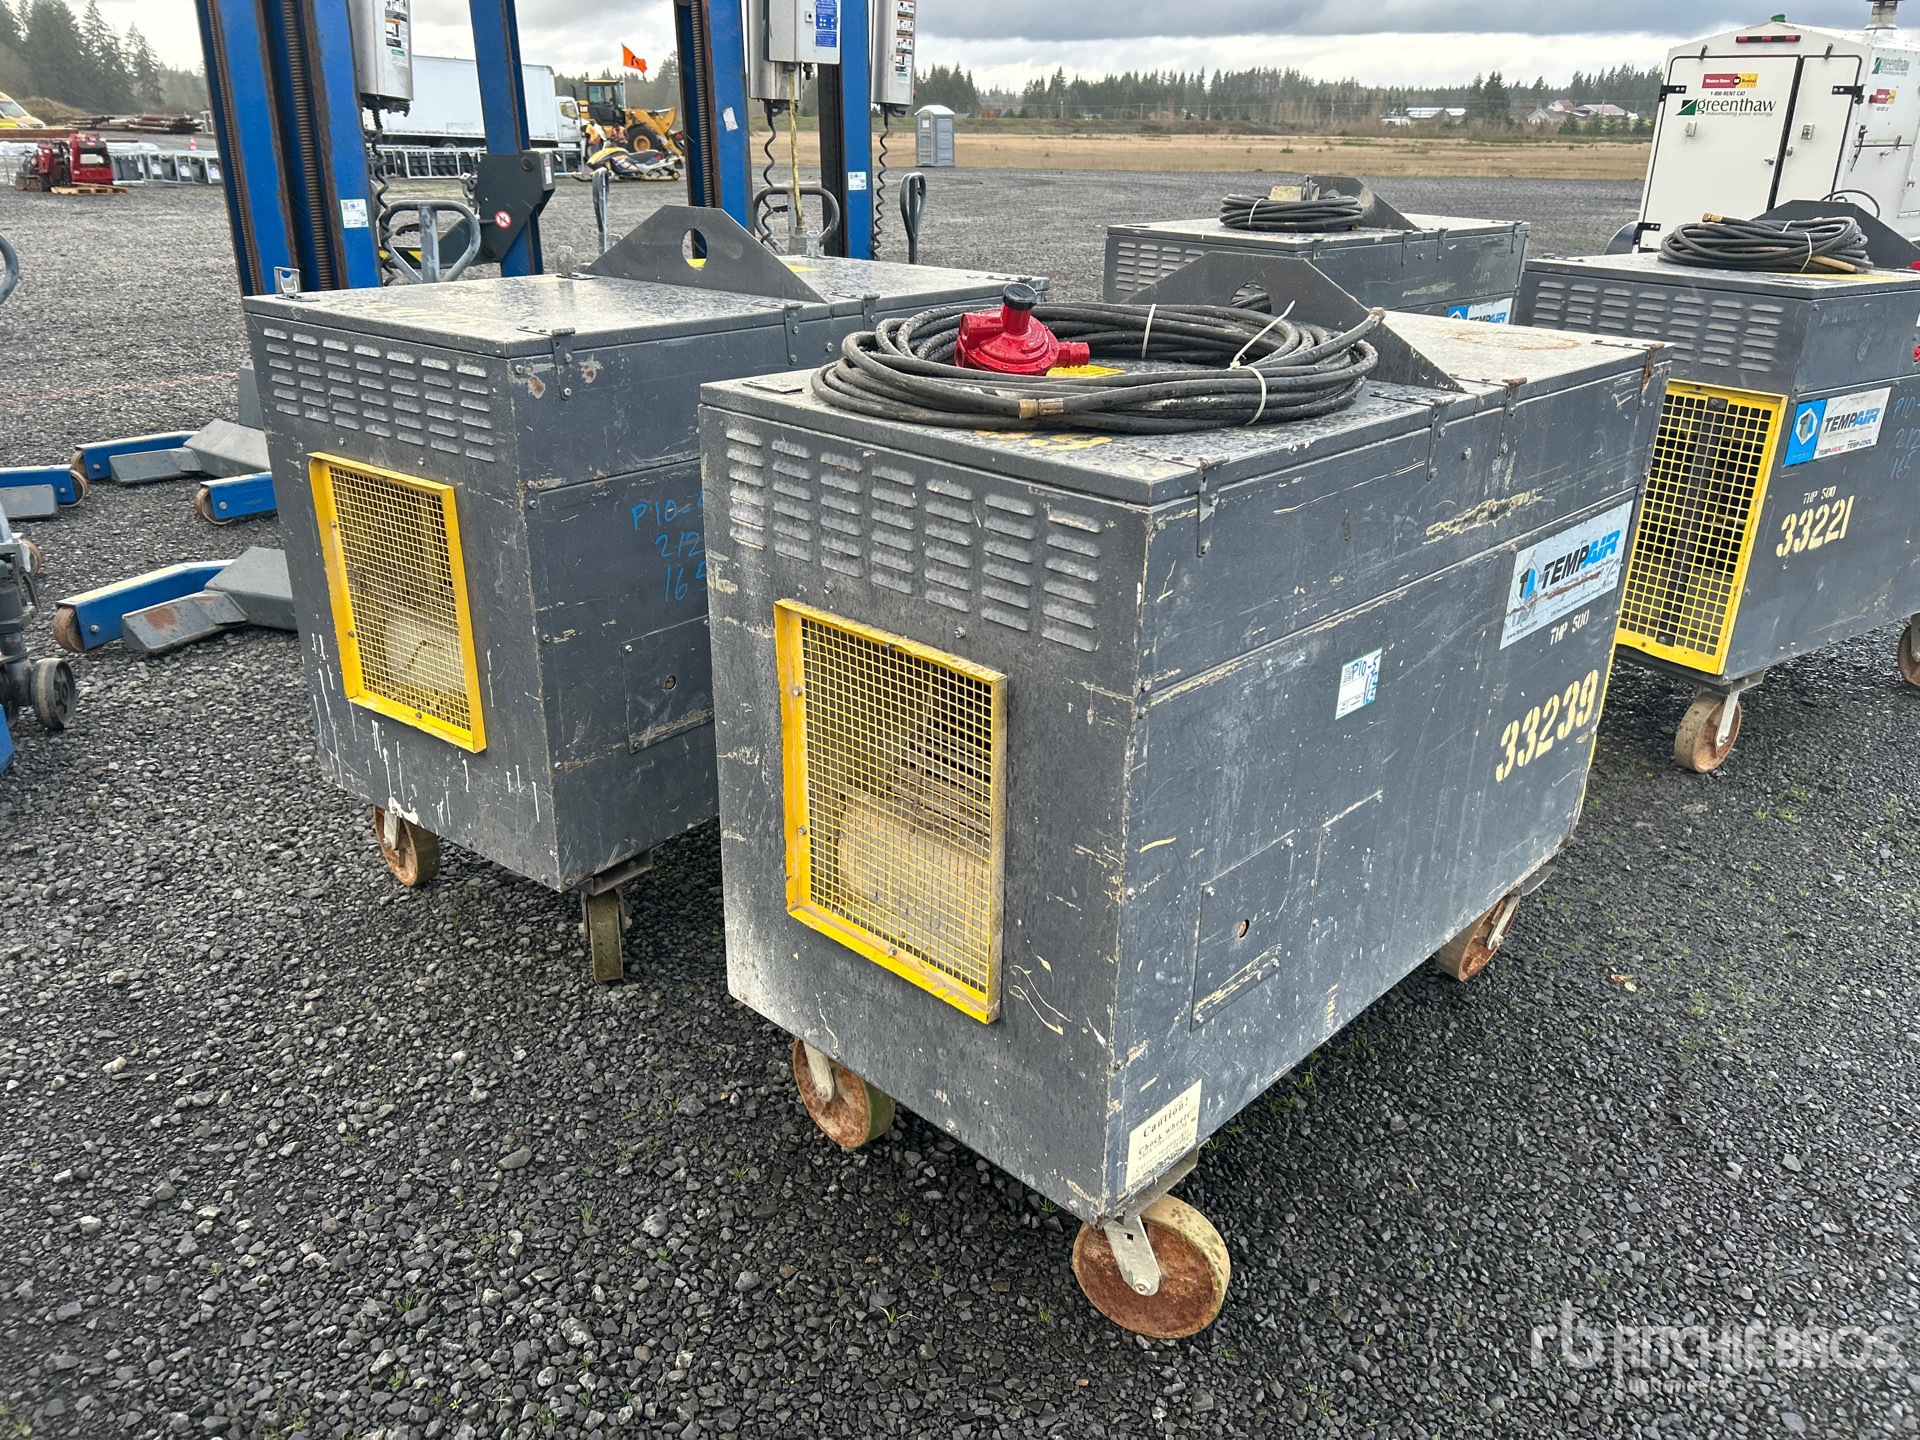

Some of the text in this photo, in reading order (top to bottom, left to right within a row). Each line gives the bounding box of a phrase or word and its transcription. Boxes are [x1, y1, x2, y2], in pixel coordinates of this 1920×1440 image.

[1697, 98, 1776, 114] greenthaw
[1824, 407, 1881, 433] TEMPAIR
[1803, 485, 1837, 504] THP 500
[655, 531, 705, 557] 212
[1776, 495, 1854, 557] 33221
[1541, 529, 1621, 590] TEMPAIR
[1550, 609, 1590, 646] THP 500
[1495, 669, 1599, 783] 33239
[1138, 1112, 1190, 1155] Chock wheels
[1143, 1096, 1188, 1138] Caution!
